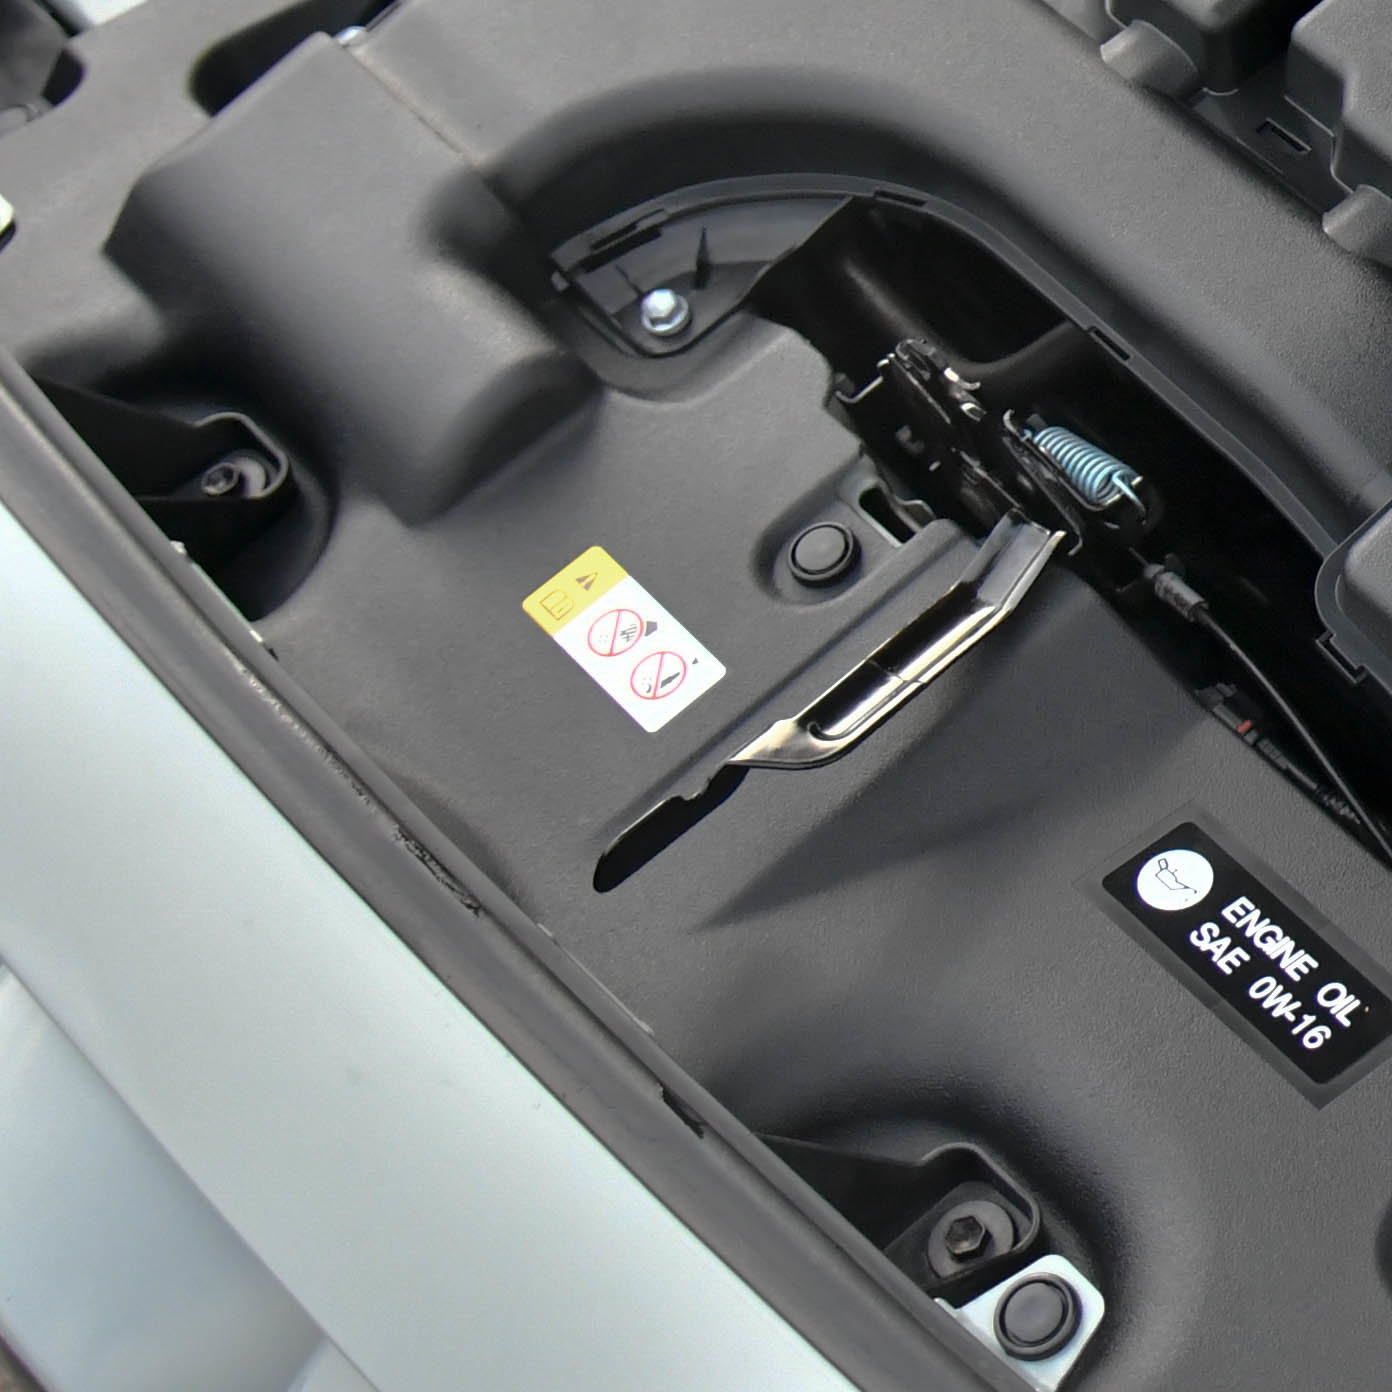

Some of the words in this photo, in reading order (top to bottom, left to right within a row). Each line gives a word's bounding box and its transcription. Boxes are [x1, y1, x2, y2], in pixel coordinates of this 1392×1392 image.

[1189, 922, 1251, 975] SAE
[1248, 976, 1332, 1050] 0W-16
[1220, 895, 1319, 982] ENGINE
[1316, 982, 1361, 1027] OIL
